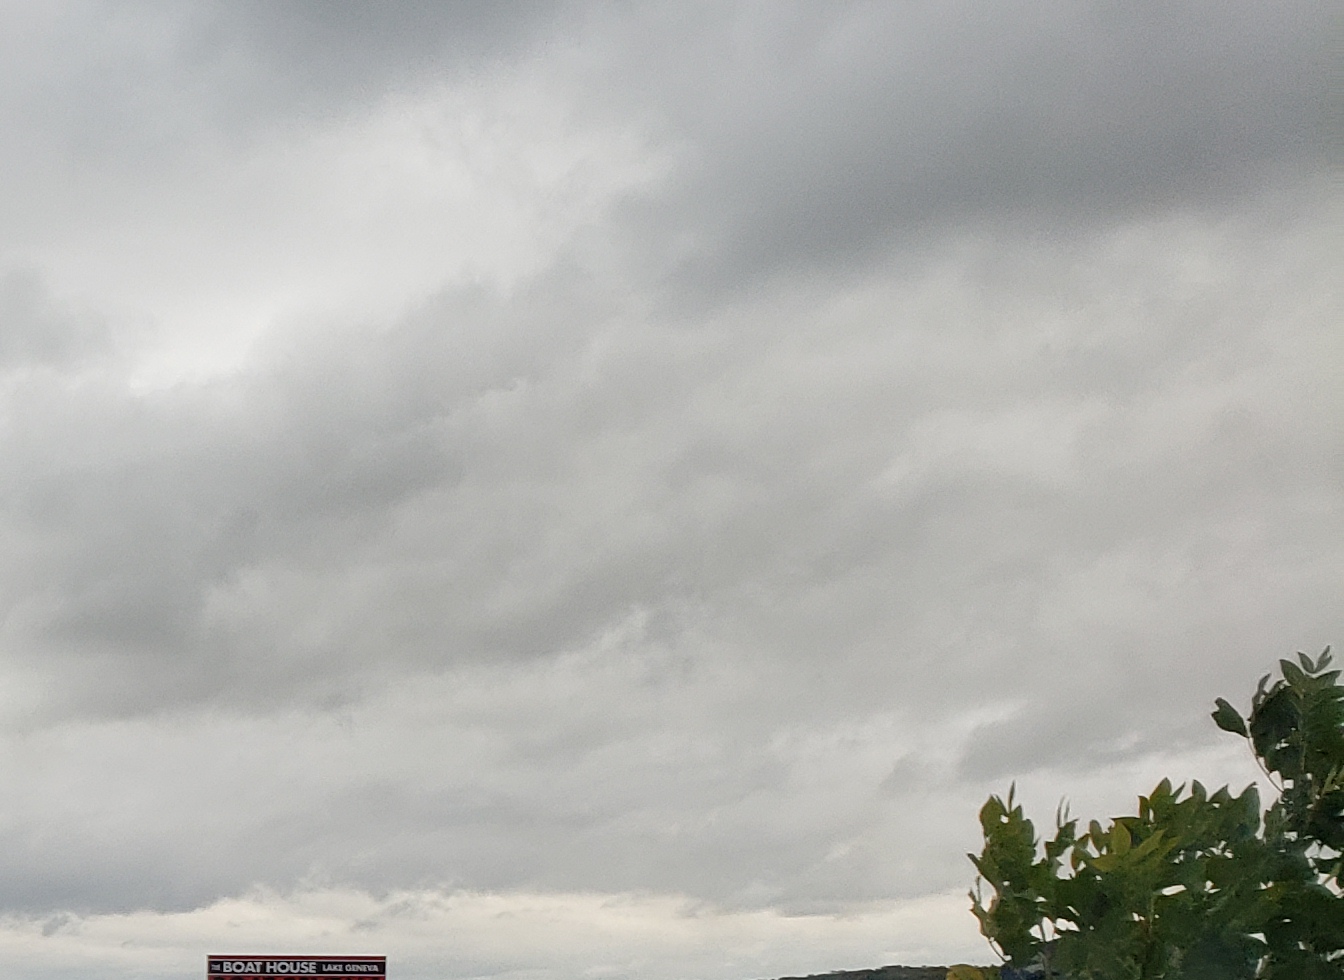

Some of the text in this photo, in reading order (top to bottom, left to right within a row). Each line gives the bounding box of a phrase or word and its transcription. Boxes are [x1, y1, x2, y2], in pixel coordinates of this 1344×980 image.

[223, 961, 262, 973] BOAT
[266, 961, 317, 974] HOUSE
[322, 963, 343, 972] LAKE
[345, 963, 379, 972] GENEVA
